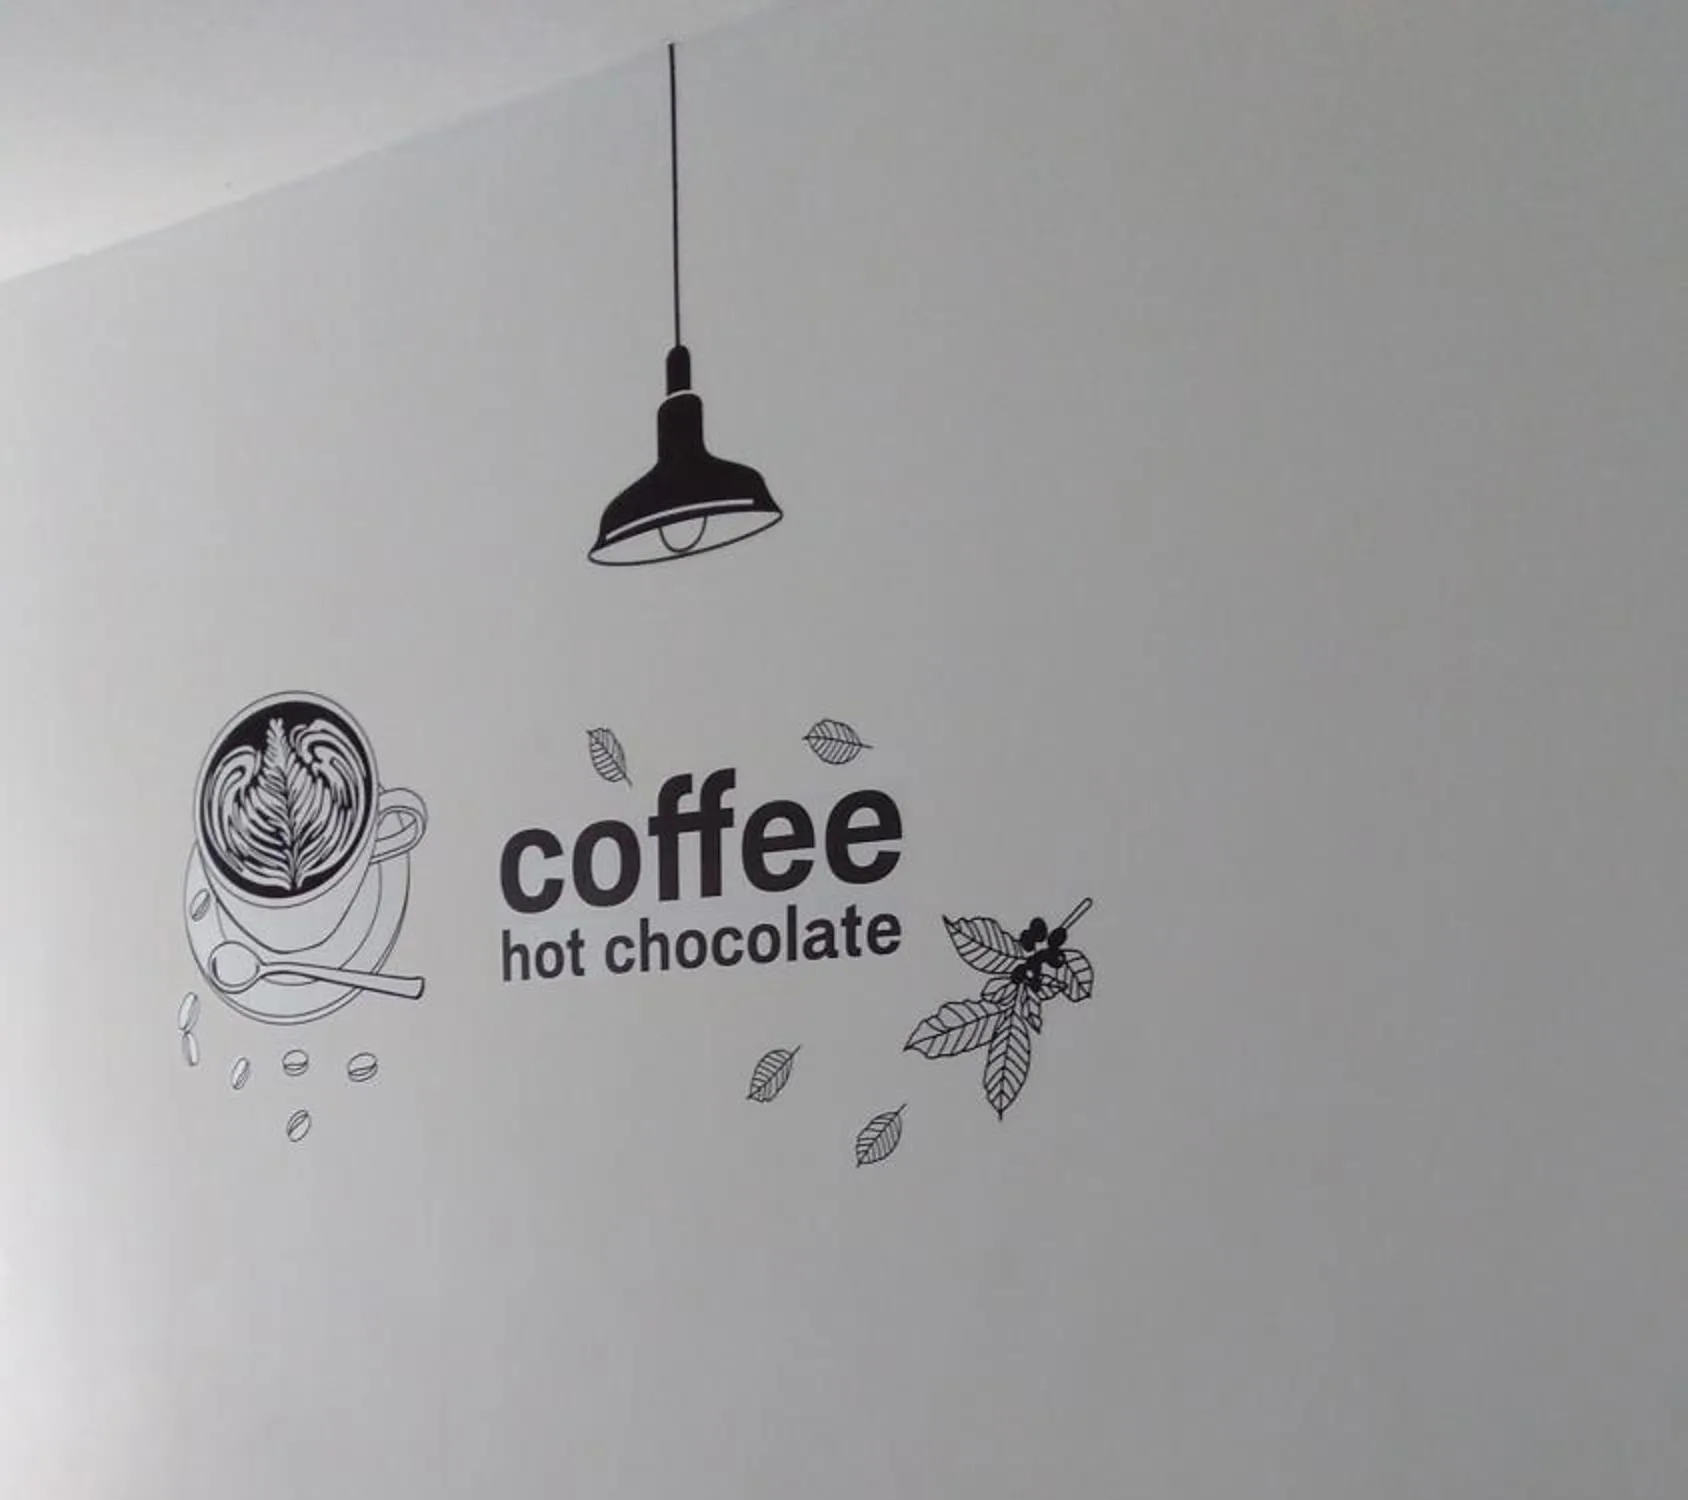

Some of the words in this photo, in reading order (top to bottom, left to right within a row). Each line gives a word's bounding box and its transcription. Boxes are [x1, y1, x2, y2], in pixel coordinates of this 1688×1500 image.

[500, 768, 903, 914] coffee
[502, 928, 585, 982] hot
[604, 904, 902, 974] chocolate
